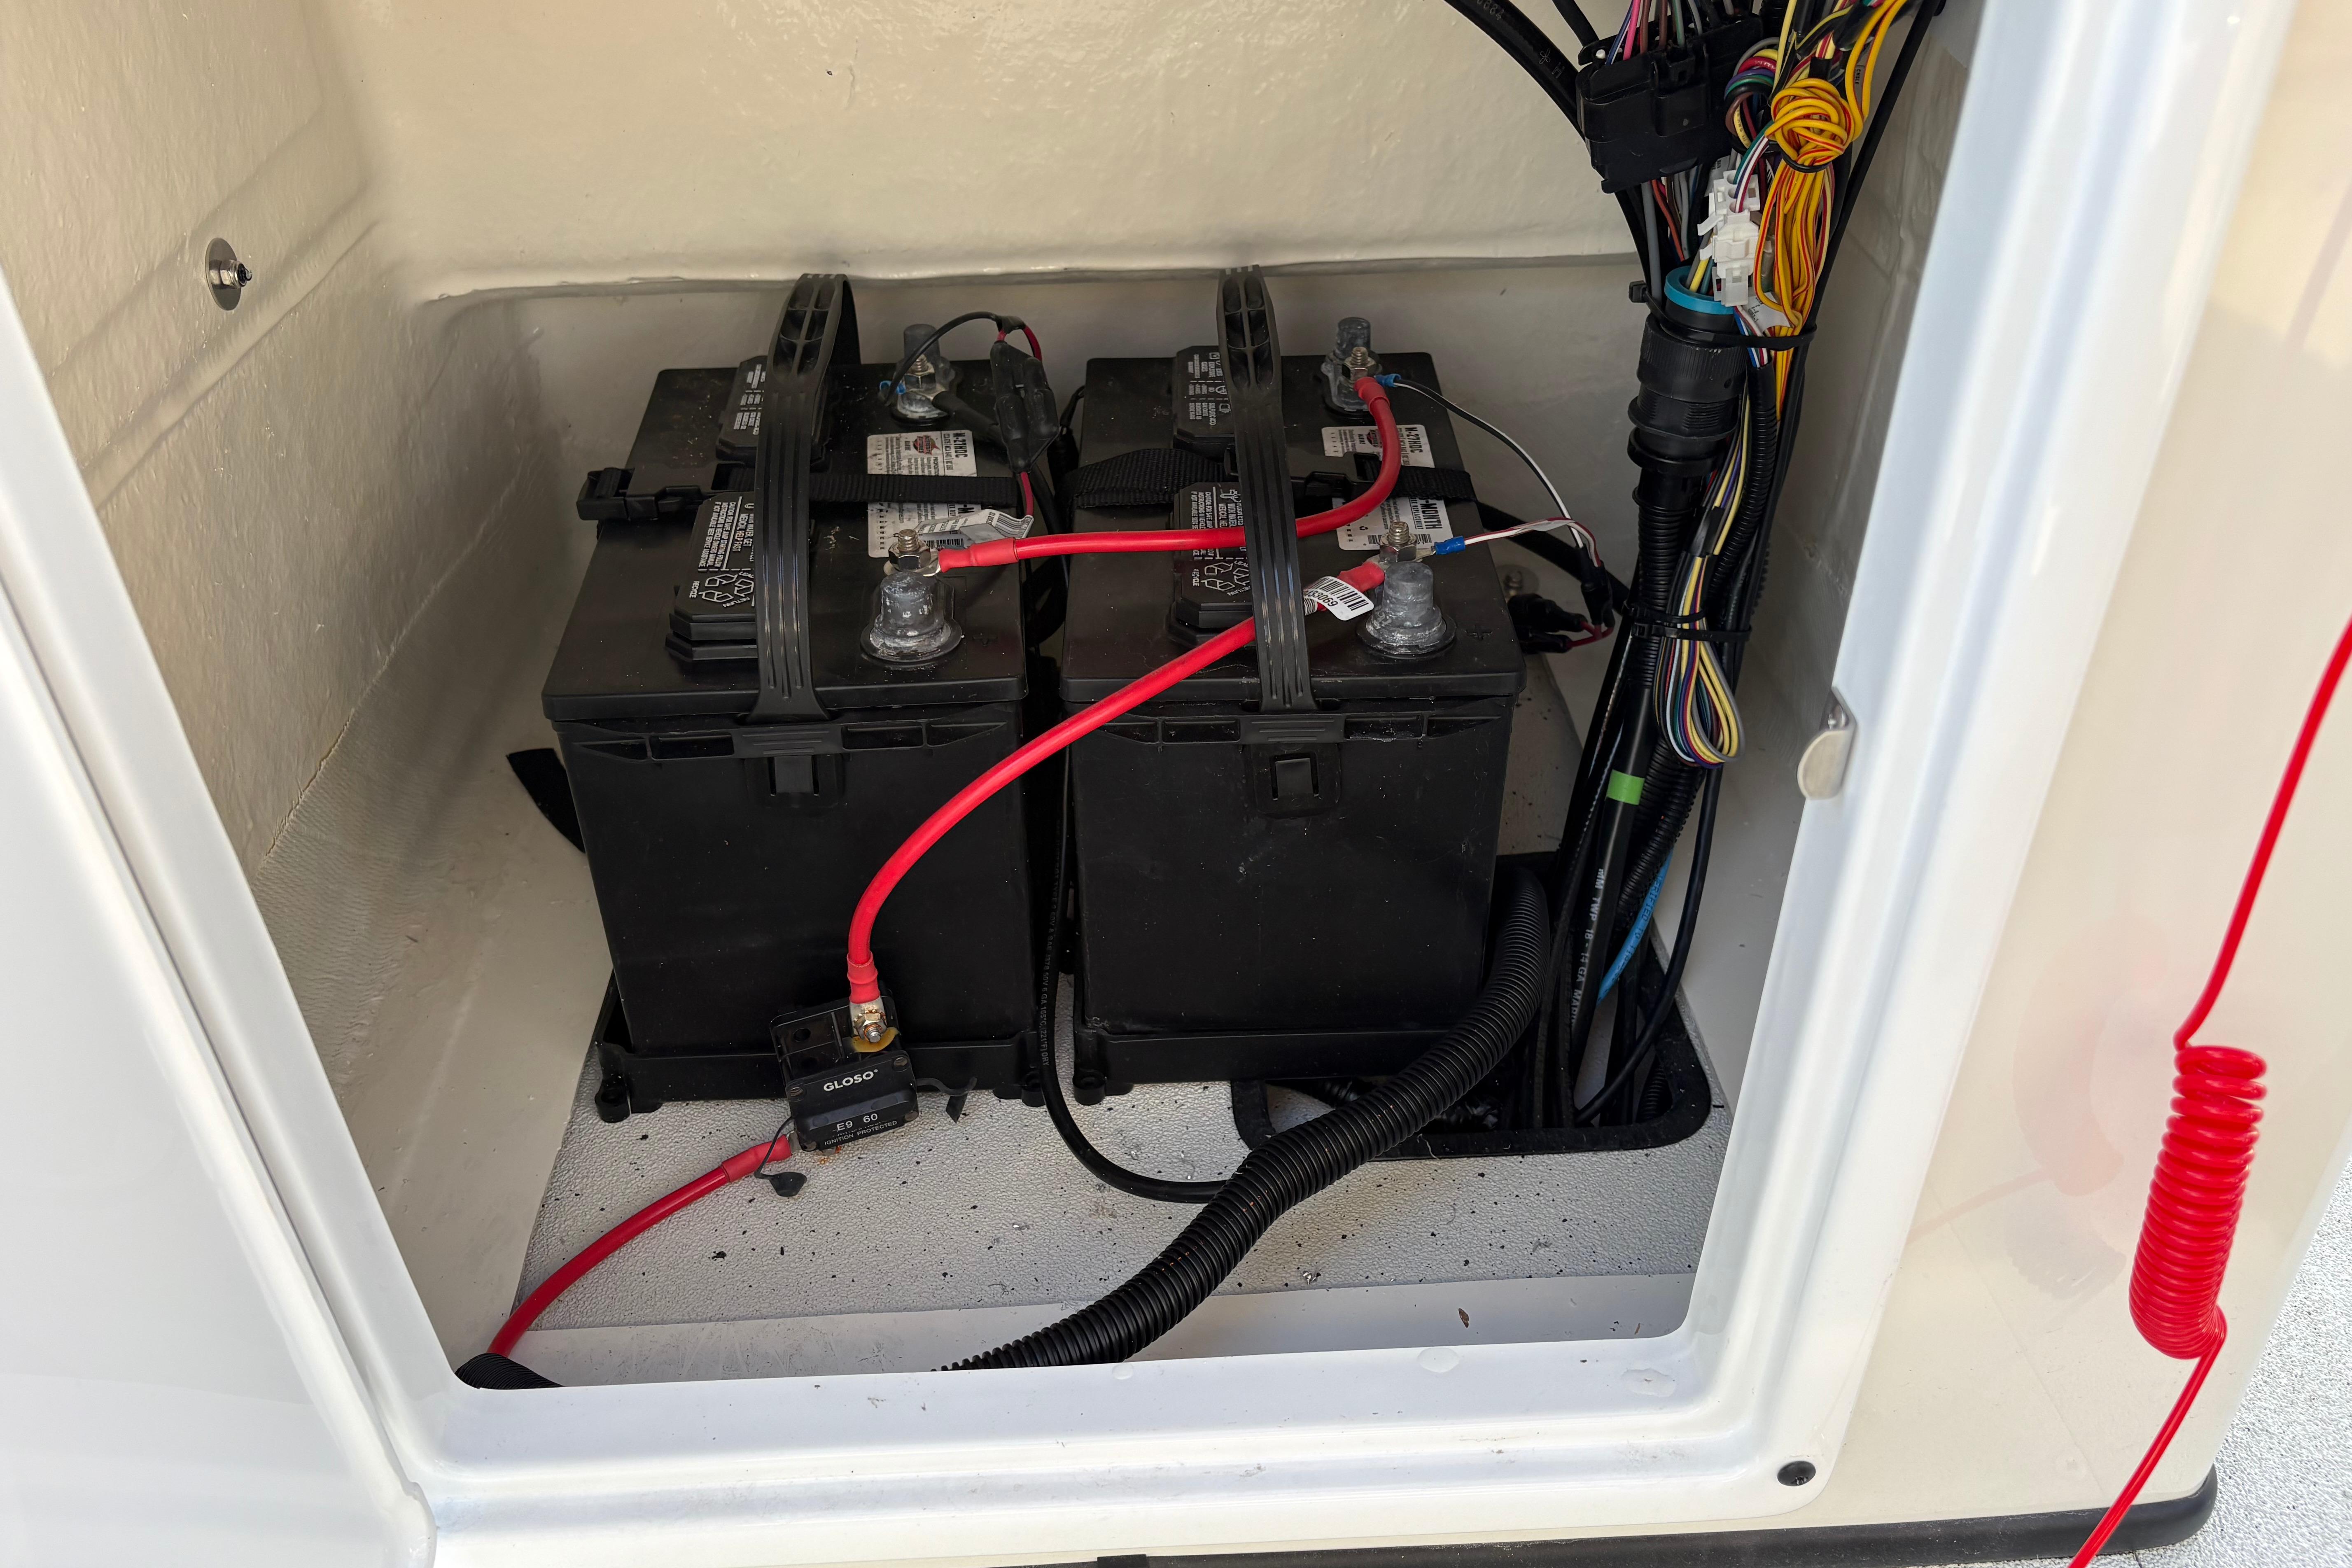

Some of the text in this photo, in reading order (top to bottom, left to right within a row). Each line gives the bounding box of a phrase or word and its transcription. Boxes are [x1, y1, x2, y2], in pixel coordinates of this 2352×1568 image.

[1218, 503, 1227, 519] MEDICAL
[735, 530, 745, 541] HELP
[732, 541, 742, 551] FAST
[689, 581, 700, 598] RECYCLE
[1589, 897, 1601, 921] TWP
[1584, 929, 1594, 939] 18
[1576, 966, 1586, 982] GA
[1041, 994, 1047, 1004] GA
[824, 1071, 873, 1092] GLOSO
[837, 1121, 853, 1131] E9
[863, 1113, 878, 1123] 60
[824, 1133, 854, 1146] IGNITION
[857, 1120, 897, 1138] PROTECTED
